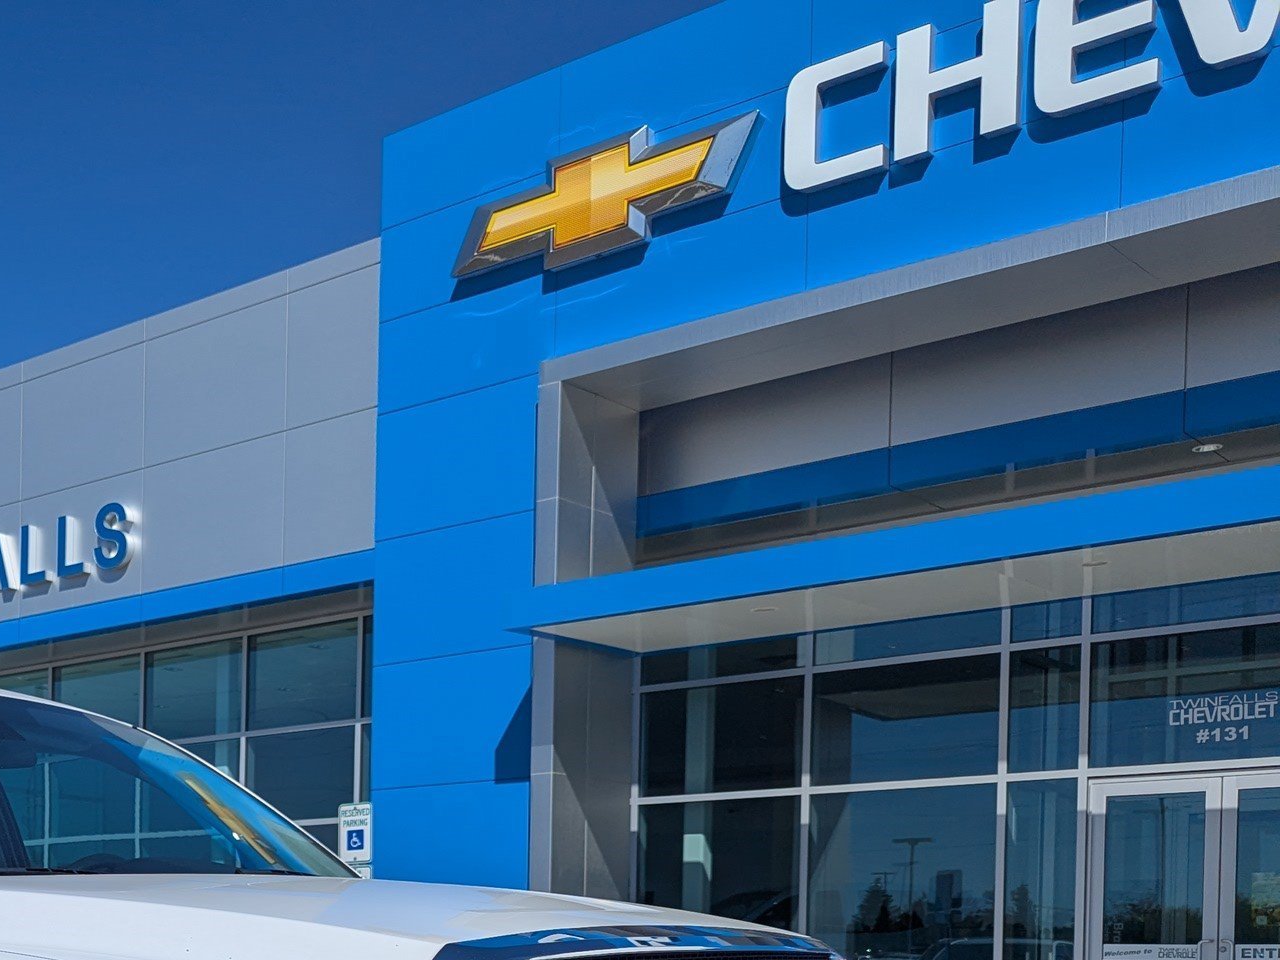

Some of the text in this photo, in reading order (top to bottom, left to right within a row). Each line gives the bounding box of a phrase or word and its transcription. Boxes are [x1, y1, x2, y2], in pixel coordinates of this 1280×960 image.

[1169, 691, 1278, 710] TWINFALLS
[1169, 701, 1279, 726] CHEVROLET
[1196, 725, 1249, 743] #131
[341, 808, 370, 817] RESERVED
[342, 818, 369, 828] PARKING
[1158, 951, 1198, 959] CHEVROLE
[1241, 947, 1280, 959] ENT
